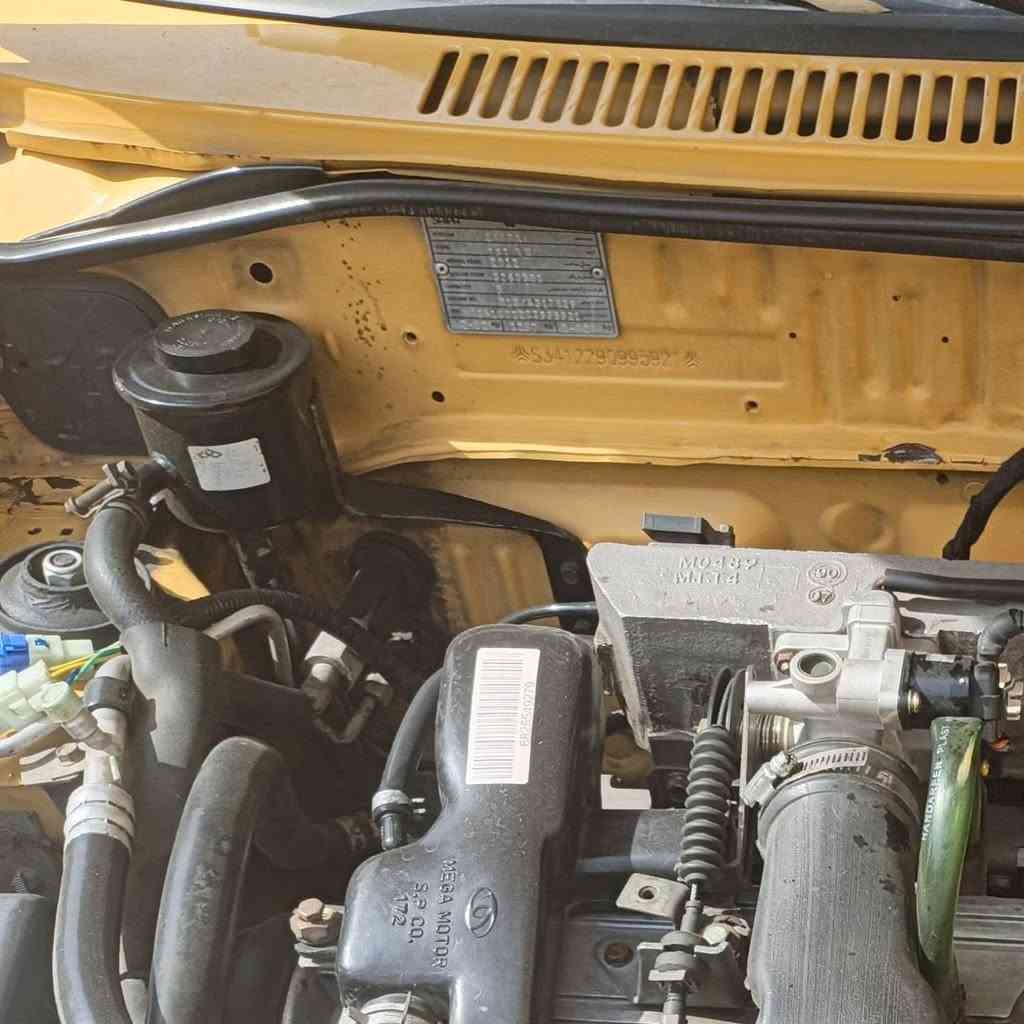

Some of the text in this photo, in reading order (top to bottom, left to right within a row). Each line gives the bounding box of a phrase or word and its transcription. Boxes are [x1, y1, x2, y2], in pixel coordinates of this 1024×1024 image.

[391, 895, 409, 926] 172
[432, 857, 457, 968] MEGA MOTOR
